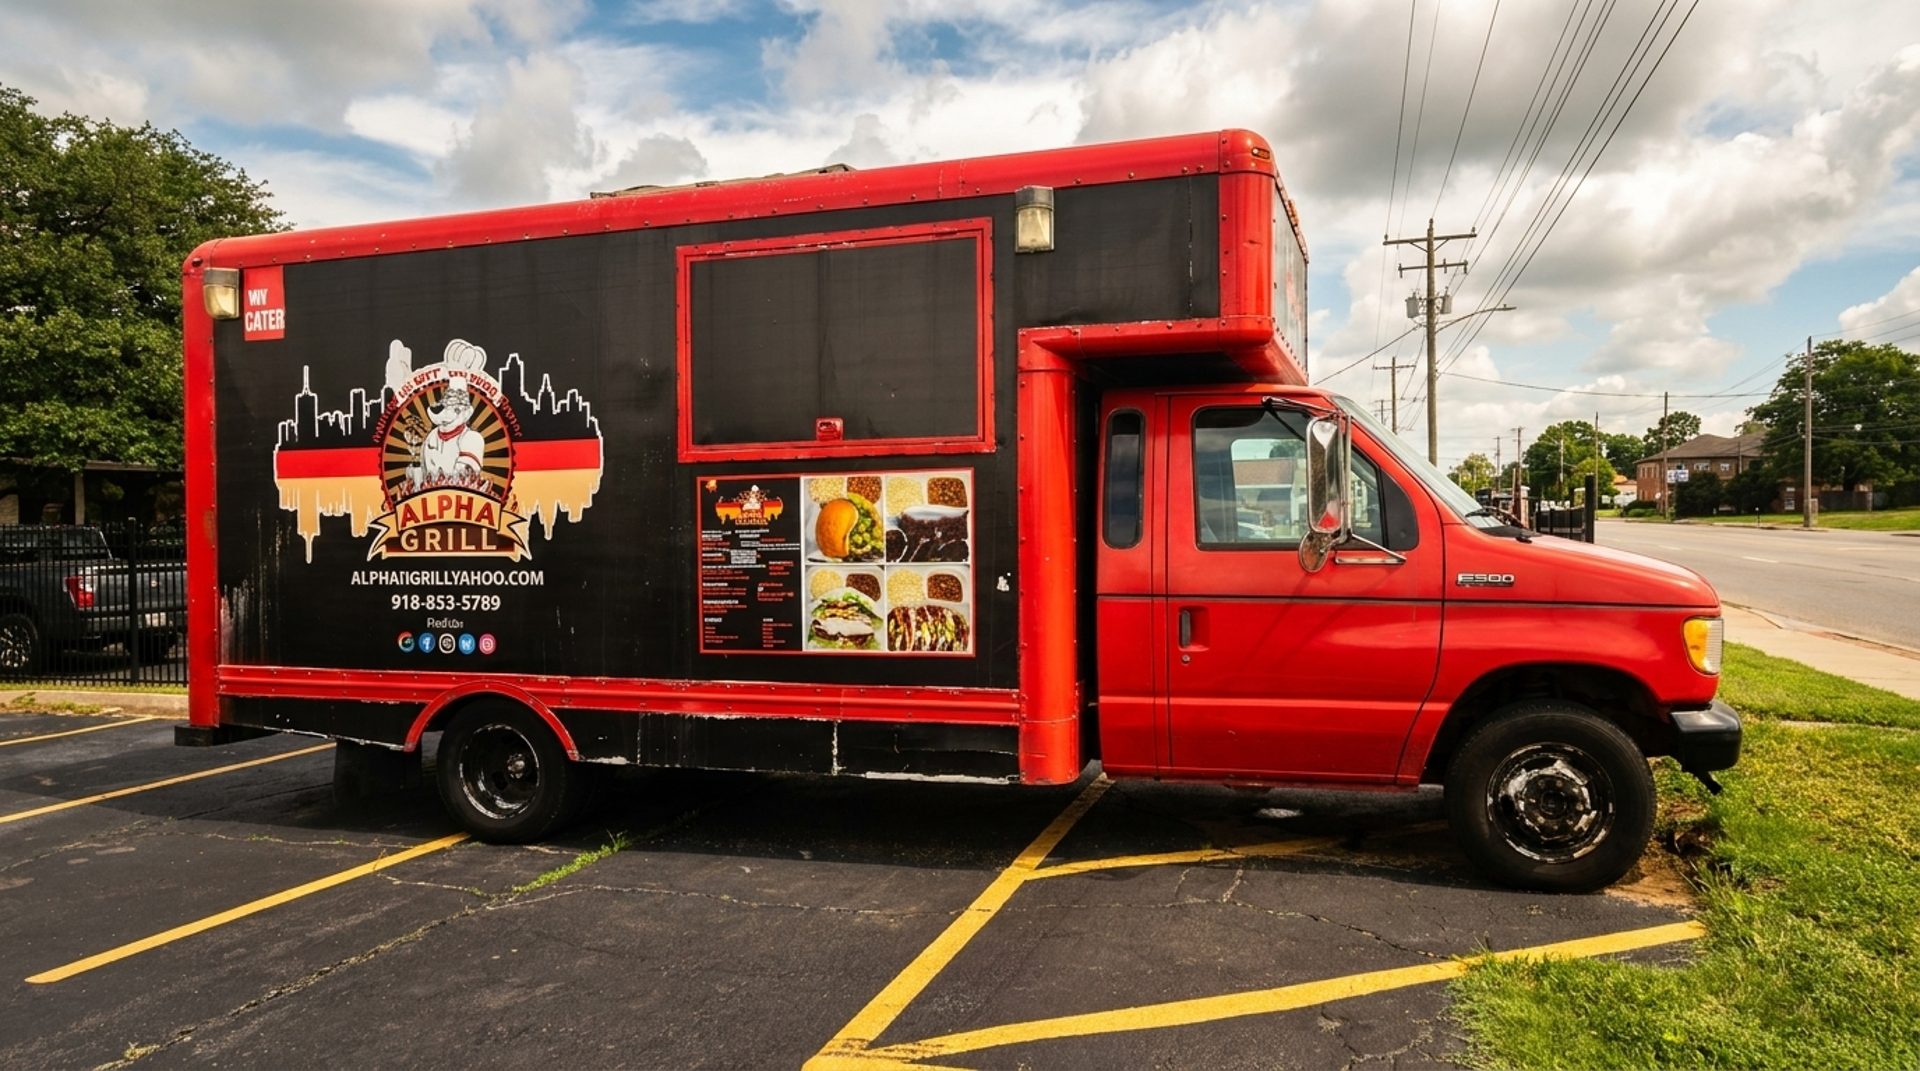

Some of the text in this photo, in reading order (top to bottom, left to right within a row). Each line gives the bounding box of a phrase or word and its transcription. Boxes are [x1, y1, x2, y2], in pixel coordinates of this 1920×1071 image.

[245, 309, 285, 332] CATER
[400, 494, 496, 529] ALPHA
[400, 528, 498, 551] GRILL
[391, 594, 501, 611] 918-853-5789
